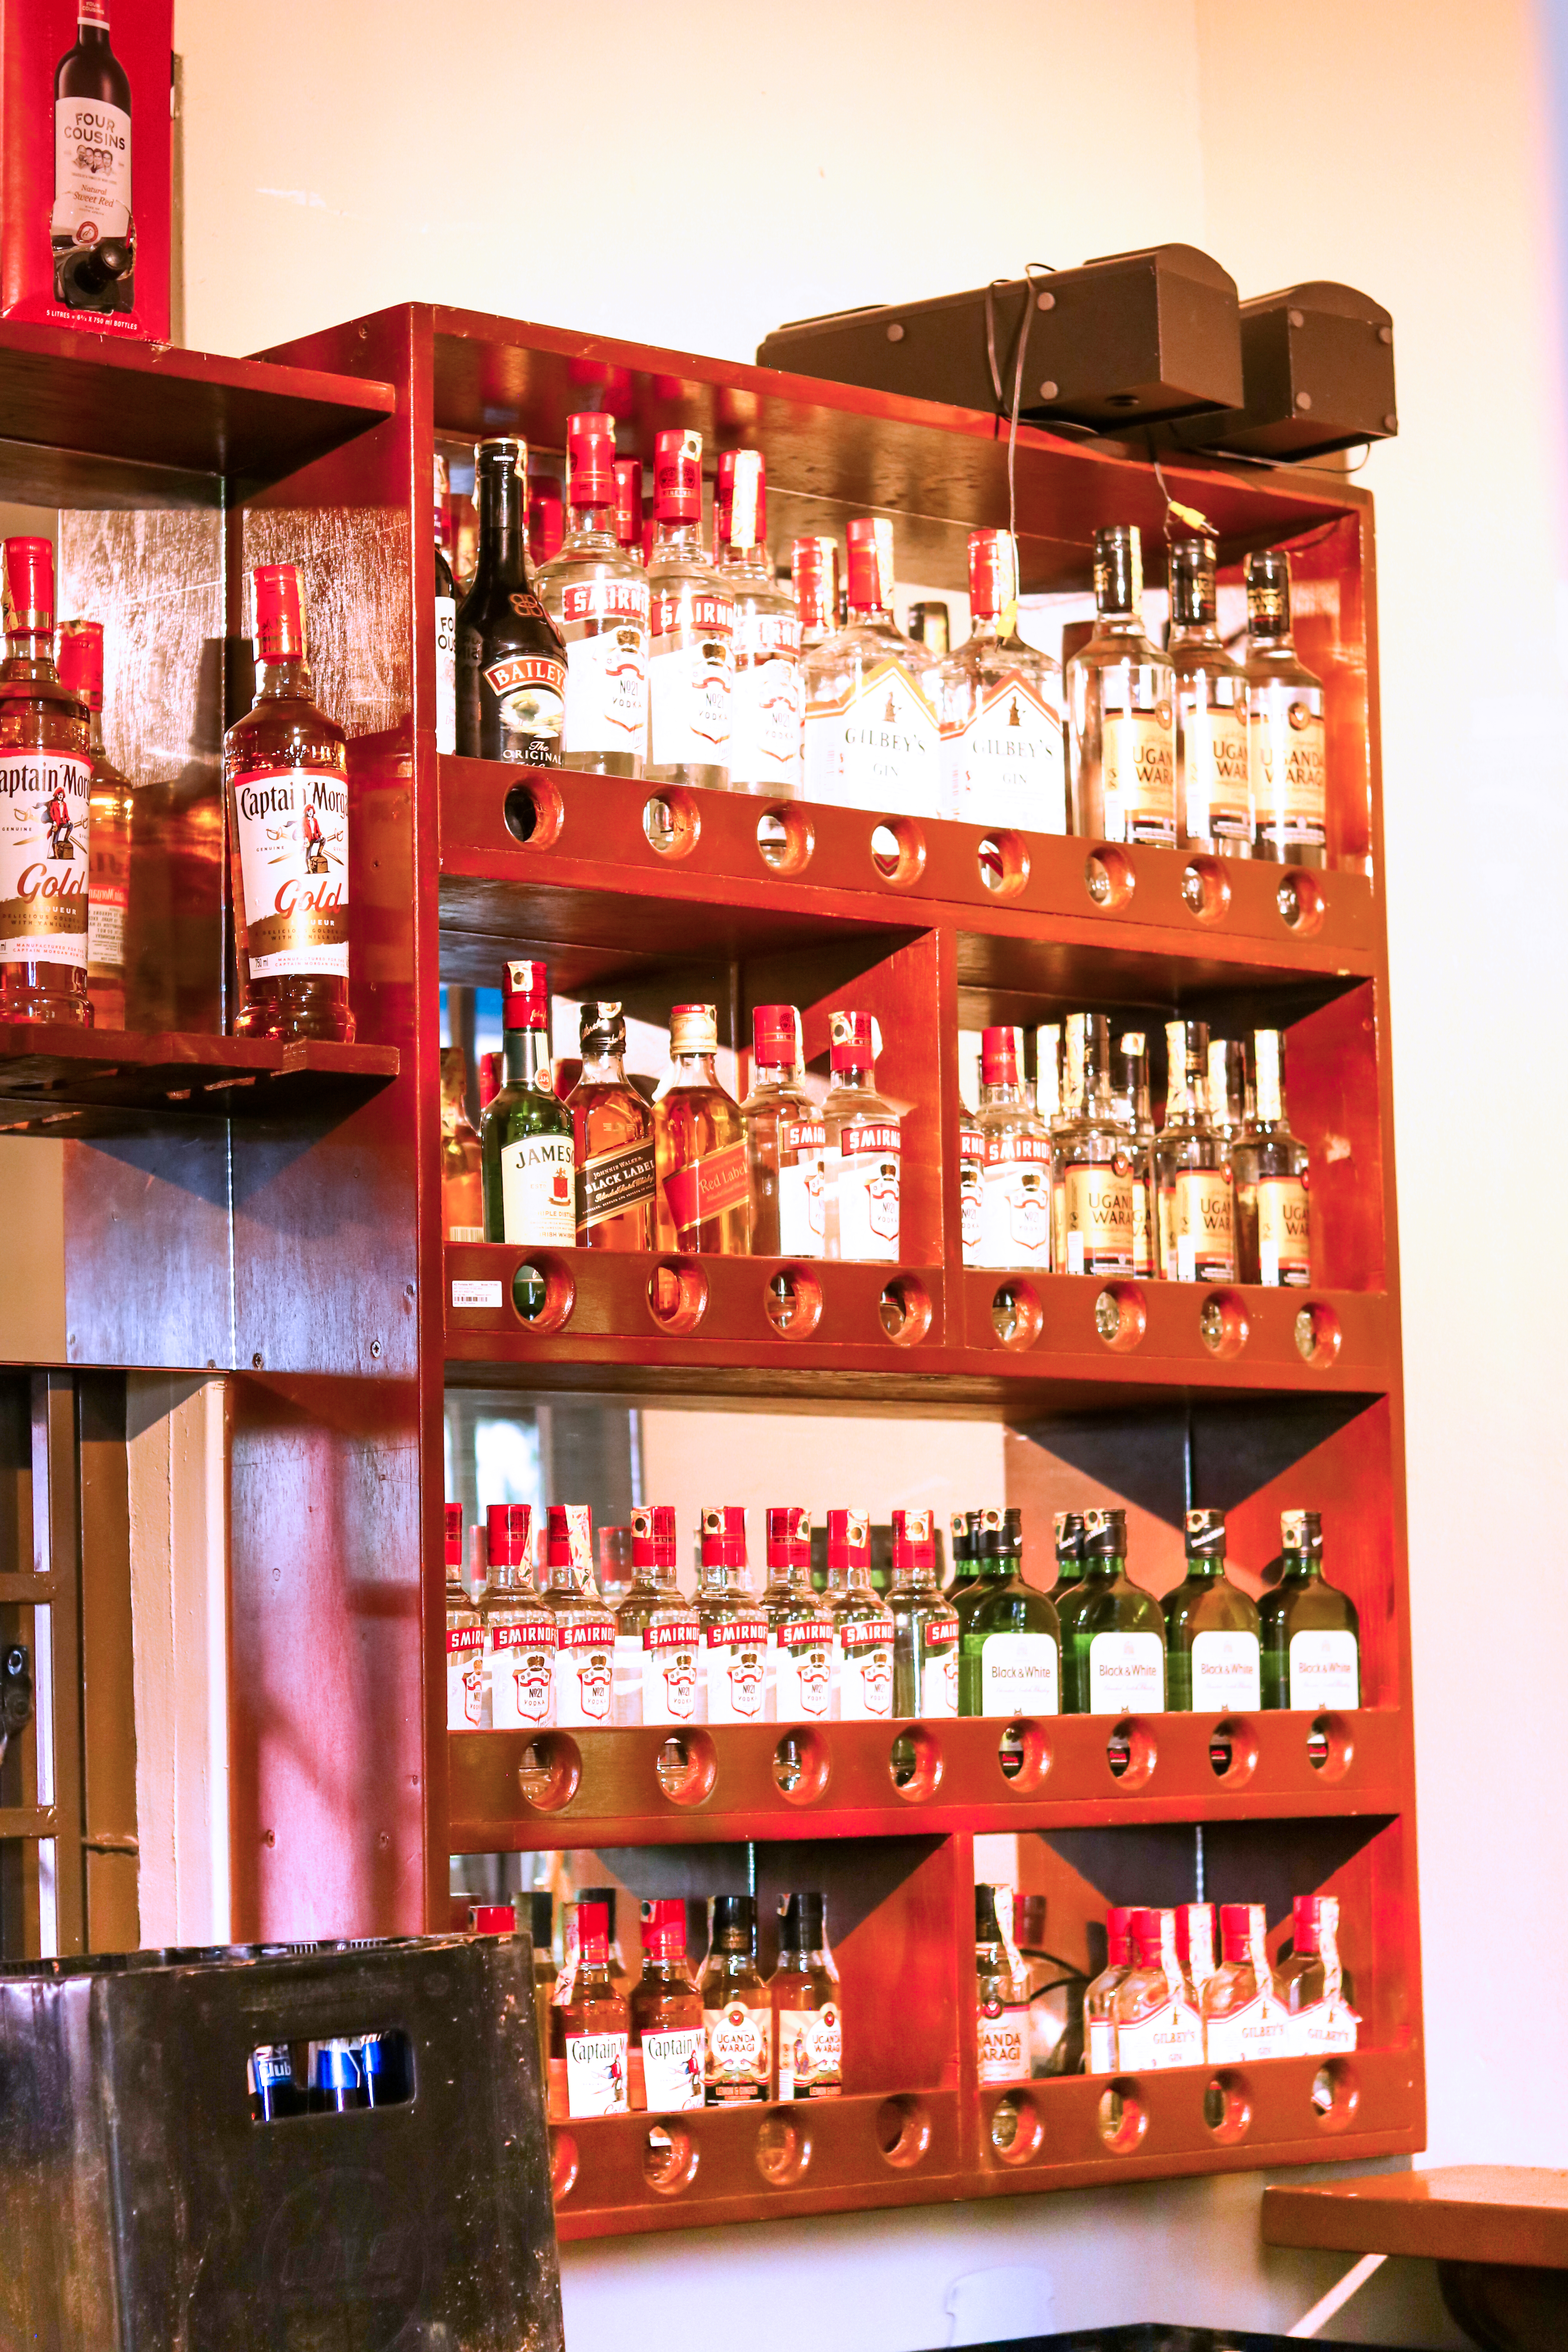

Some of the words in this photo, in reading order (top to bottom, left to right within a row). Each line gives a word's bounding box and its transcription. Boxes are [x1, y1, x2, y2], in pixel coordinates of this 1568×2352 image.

[75, 113, 114, 132] FOUR
[64, 126, 125, 150] COUSINS
[81, 184, 107, 195] Natural
[73, 192, 97, 204] Sweet
[98, 197, 114, 207] Red
[114, 320, 137, 330] BOTTLES
[440, 617, 455, 632] FO
[493, 662, 567, 692] BAILEYS
[612, 697, 642, 708] VODKA
[699, 710, 728, 721] VODKA
[765, 730, 793, 740] VODKA
[845, 728, 926, 756] GILBEY'S
[529, 741, 549, 751] The
[503, 750, 562, 765] ORIGINAL
[873, 763, 898, 777] GIN
[1002, 773, 1027, 785] GIN
[17, 863, 85, 904] Gold
[275, 879, 342, 919] Gold
[263, 957, 269, 967] ml
[593, 1164, 619, 1180] JOHNNIE
[699, 1173, 721, 1194] Red
[722, 1161, 748, 1183] Label
[584, 1172, 622, 1194] BLACK
[595, 1185, 620, 1203] Blended
[634, 1174, 653, 1188] Whisky
[992, 1666, 1016, 1678] Black
[1018, 1668, 1024, 1678] &
[1024, 1666, 1050, 1678] White
[1100, 1665, 1123, 1676] Black
[1125, 1667, 1131, 1676] &
[1132, 1665, 1156, 1676] White
[1201, 1664, 1223, 1674] Black
[1231, 1664, 1253, 1674] White
[1299, 1662, 1320, 1673] Black
[1328, 1662, 1351, 1673] White
[1154, 2031, 1196, 2045] GILBEY'S
[1242, 2024, 1285, 2038] GILBEY'S
[717, 2034, 755, 2043] UGANDA
[572, 2039, 616, 2063] Captain
[649, 2035, 692, 2060] Captain
[718, 2043, 755, 2052] WARAGI
[1169, 2054, 1182, 2062] GIN
